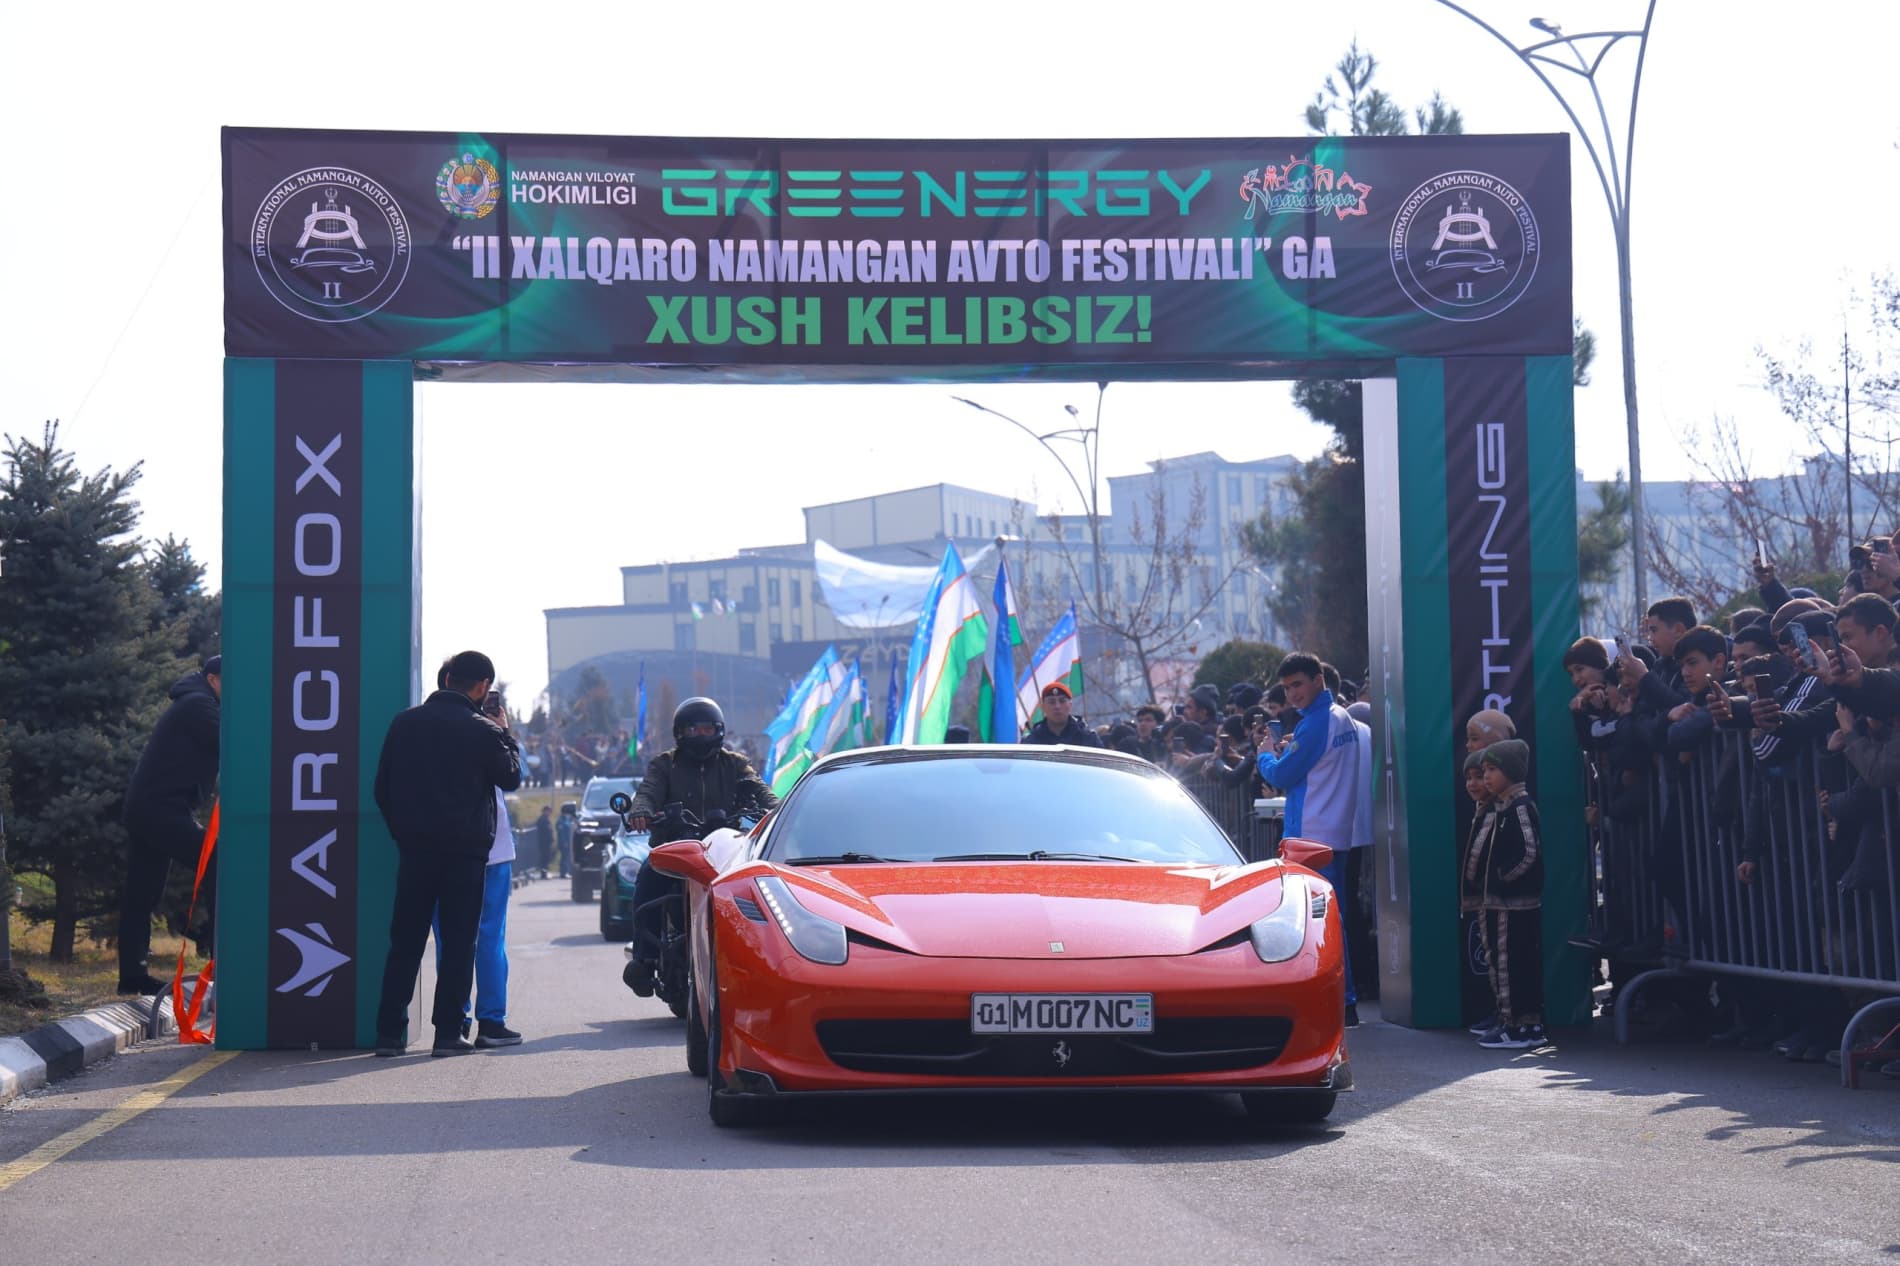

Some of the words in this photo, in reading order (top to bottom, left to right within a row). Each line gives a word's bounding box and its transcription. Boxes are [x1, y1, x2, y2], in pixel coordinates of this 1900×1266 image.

[511, 171, 582, 183] NAMANGAN
[586, 172, 636, 184] VILOYAT
[511, 184, 637, 205] HOKIMLIGI
[662, 169, 1211, 217] GREENERGY
[256, 181, 297, 257] INTERNATIONAL
[299, 171, 361, 187] NAMANGAN
[361, 182, 389, 206] AUTO
[386, 203, 407, 256] FESTIVAL
[1393, 187, 1433, 261] INTERNATIONAL
[1433, 174, 1494, 190] NAMANGAN
[1494, 184, 1519, 207] AUTO
[1516, 206, 1536, 255] FESTIVAL
[511, 236, 697, 285] XALQARO
[709, 239, 937, 283] NAMANGAN
[946, 239, 1050, 283] AVTO
[1282, 236, 1337, 280] GA
[646, 295, 821, 345] XUSH
[848, 295, 1152, 345] KELIBSIZ!
[1476, 423, 1512, 712] RTHING
[291, 432, 342, 899] ARCFOX
[978, 1003, 1008, 1025] 01
